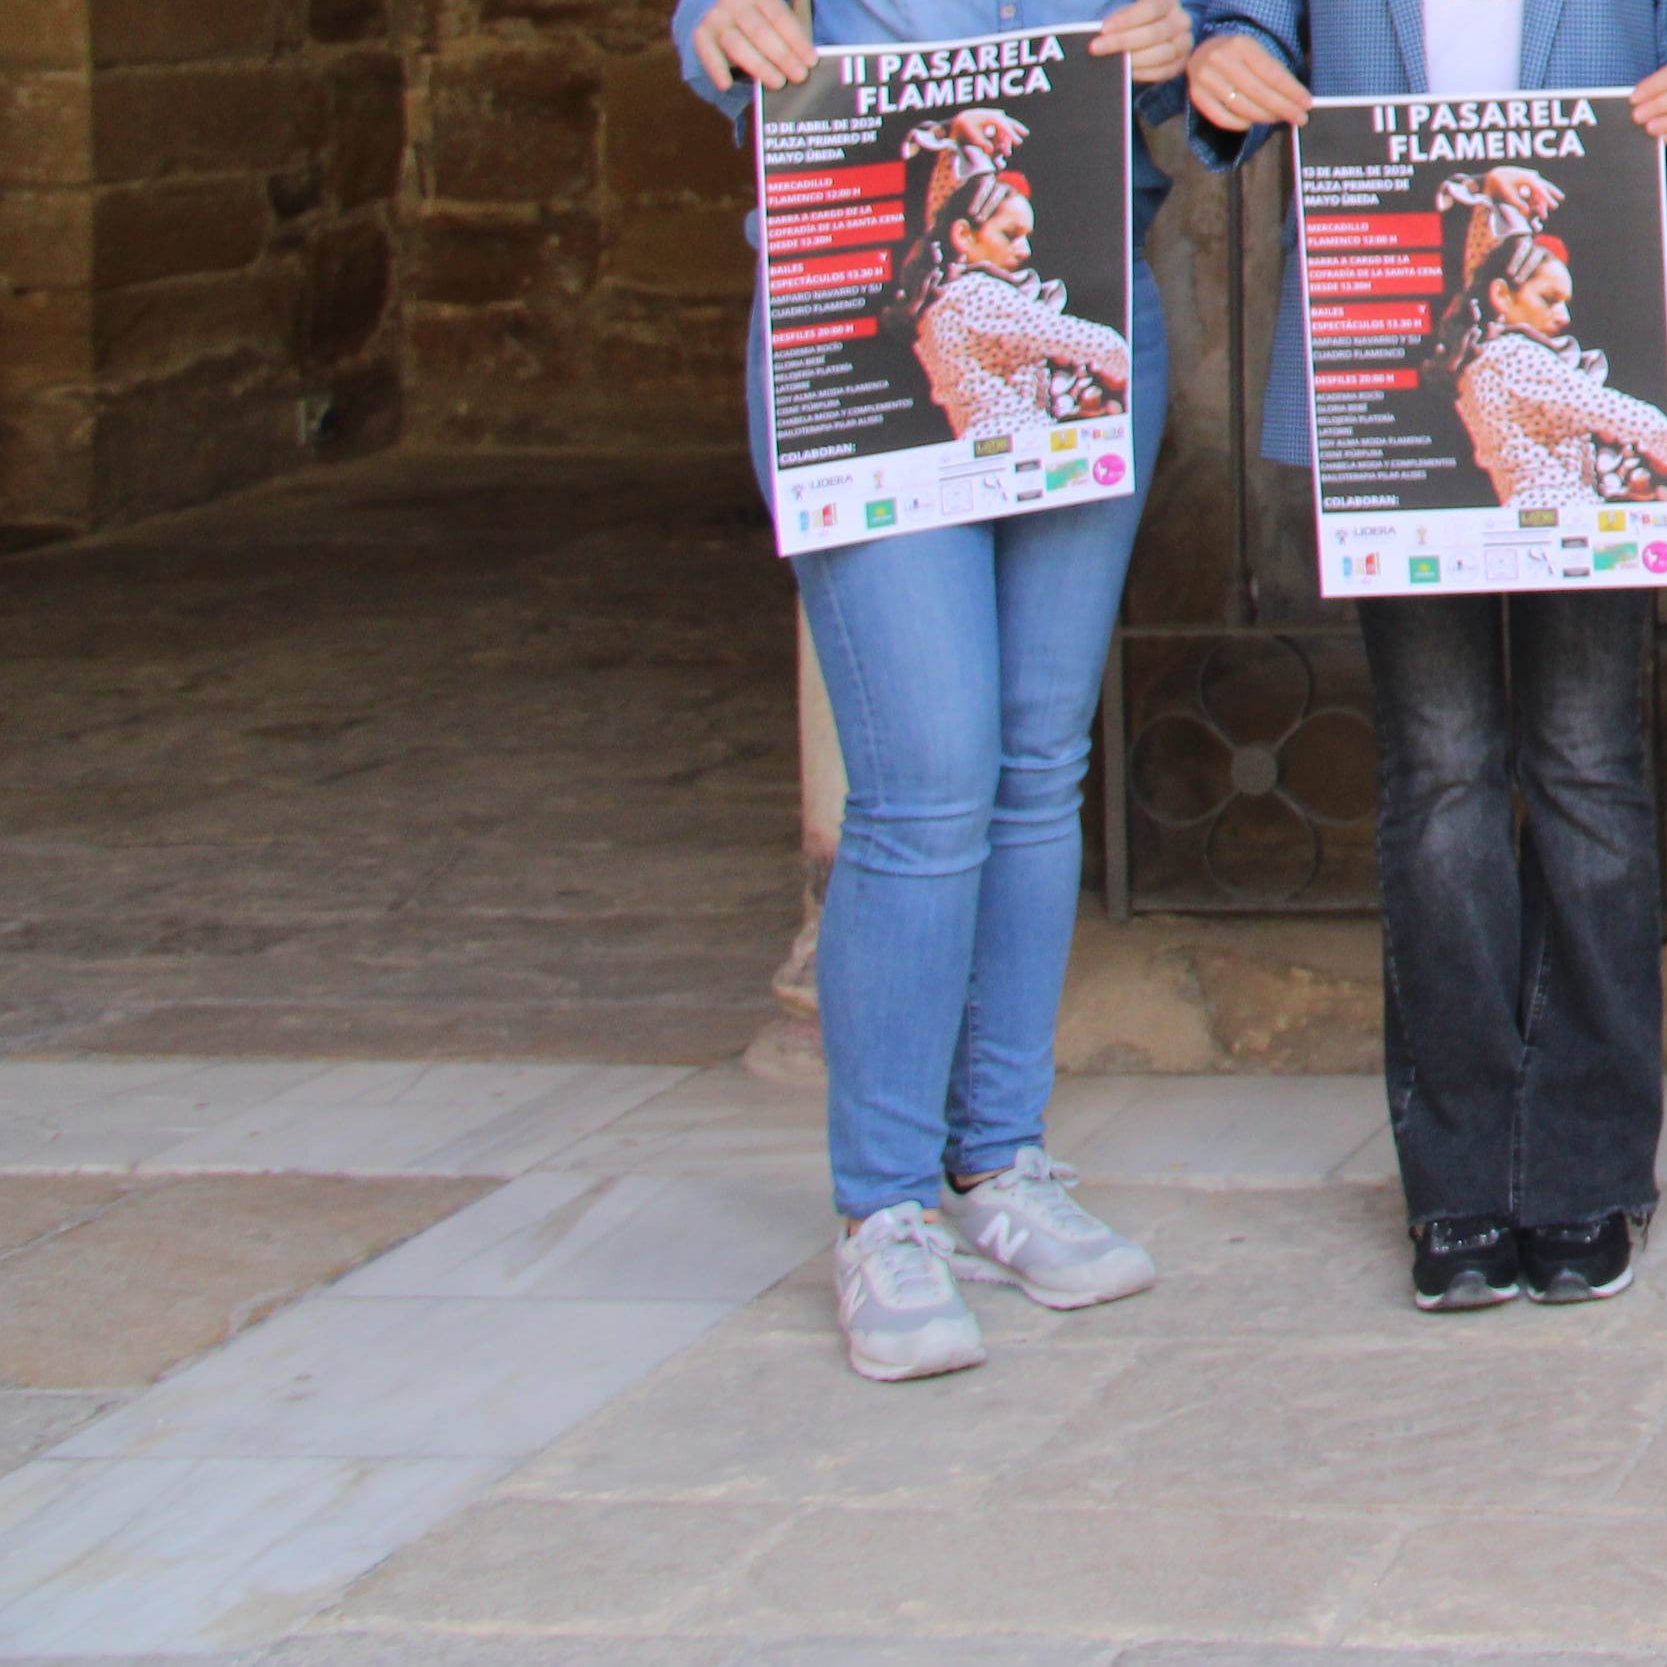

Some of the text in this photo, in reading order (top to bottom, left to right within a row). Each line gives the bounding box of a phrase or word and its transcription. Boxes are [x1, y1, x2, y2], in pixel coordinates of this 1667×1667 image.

[843, 35, 1062, 84] II PASARELA
[858, 65, 1050, 115] FLAMENCA
[1373, 98, 1596, 132] II PASARELA
[1389, 129, 1585, 161] FLAMENCA
